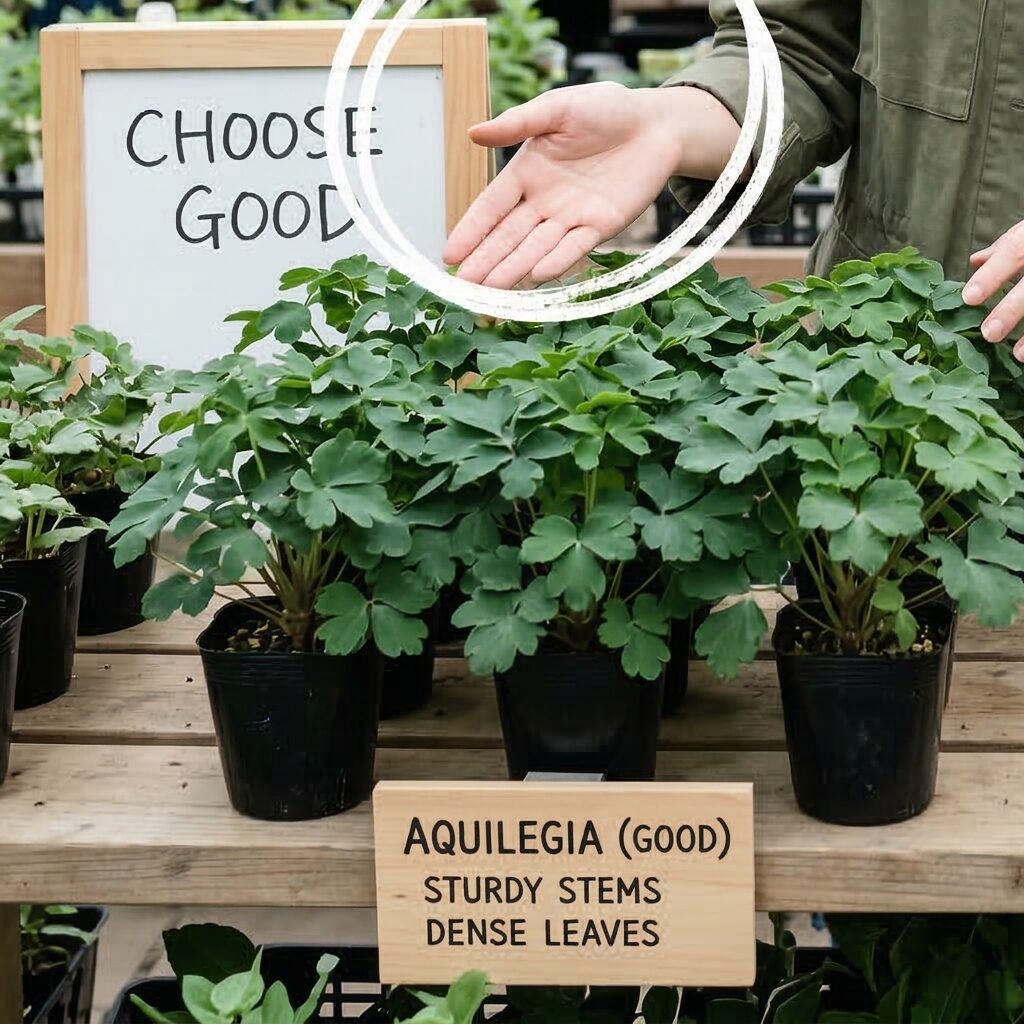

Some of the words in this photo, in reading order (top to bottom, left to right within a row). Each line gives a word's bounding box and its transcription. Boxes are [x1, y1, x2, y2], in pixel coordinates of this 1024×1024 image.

[126, 106, 383, 167] CHOOSE
[175, 184, 361, 250] GOOD
[403, 816, 603, 856] AQUILEGIA
[619, 817, 731, 860] (GOOD)
[424, 876, 542, 904] STURDY
[559, 876, 662, 905] STEMS
[427, 918, 527, 946] DENSE
[545, 918, 660, 947] LEAVES
